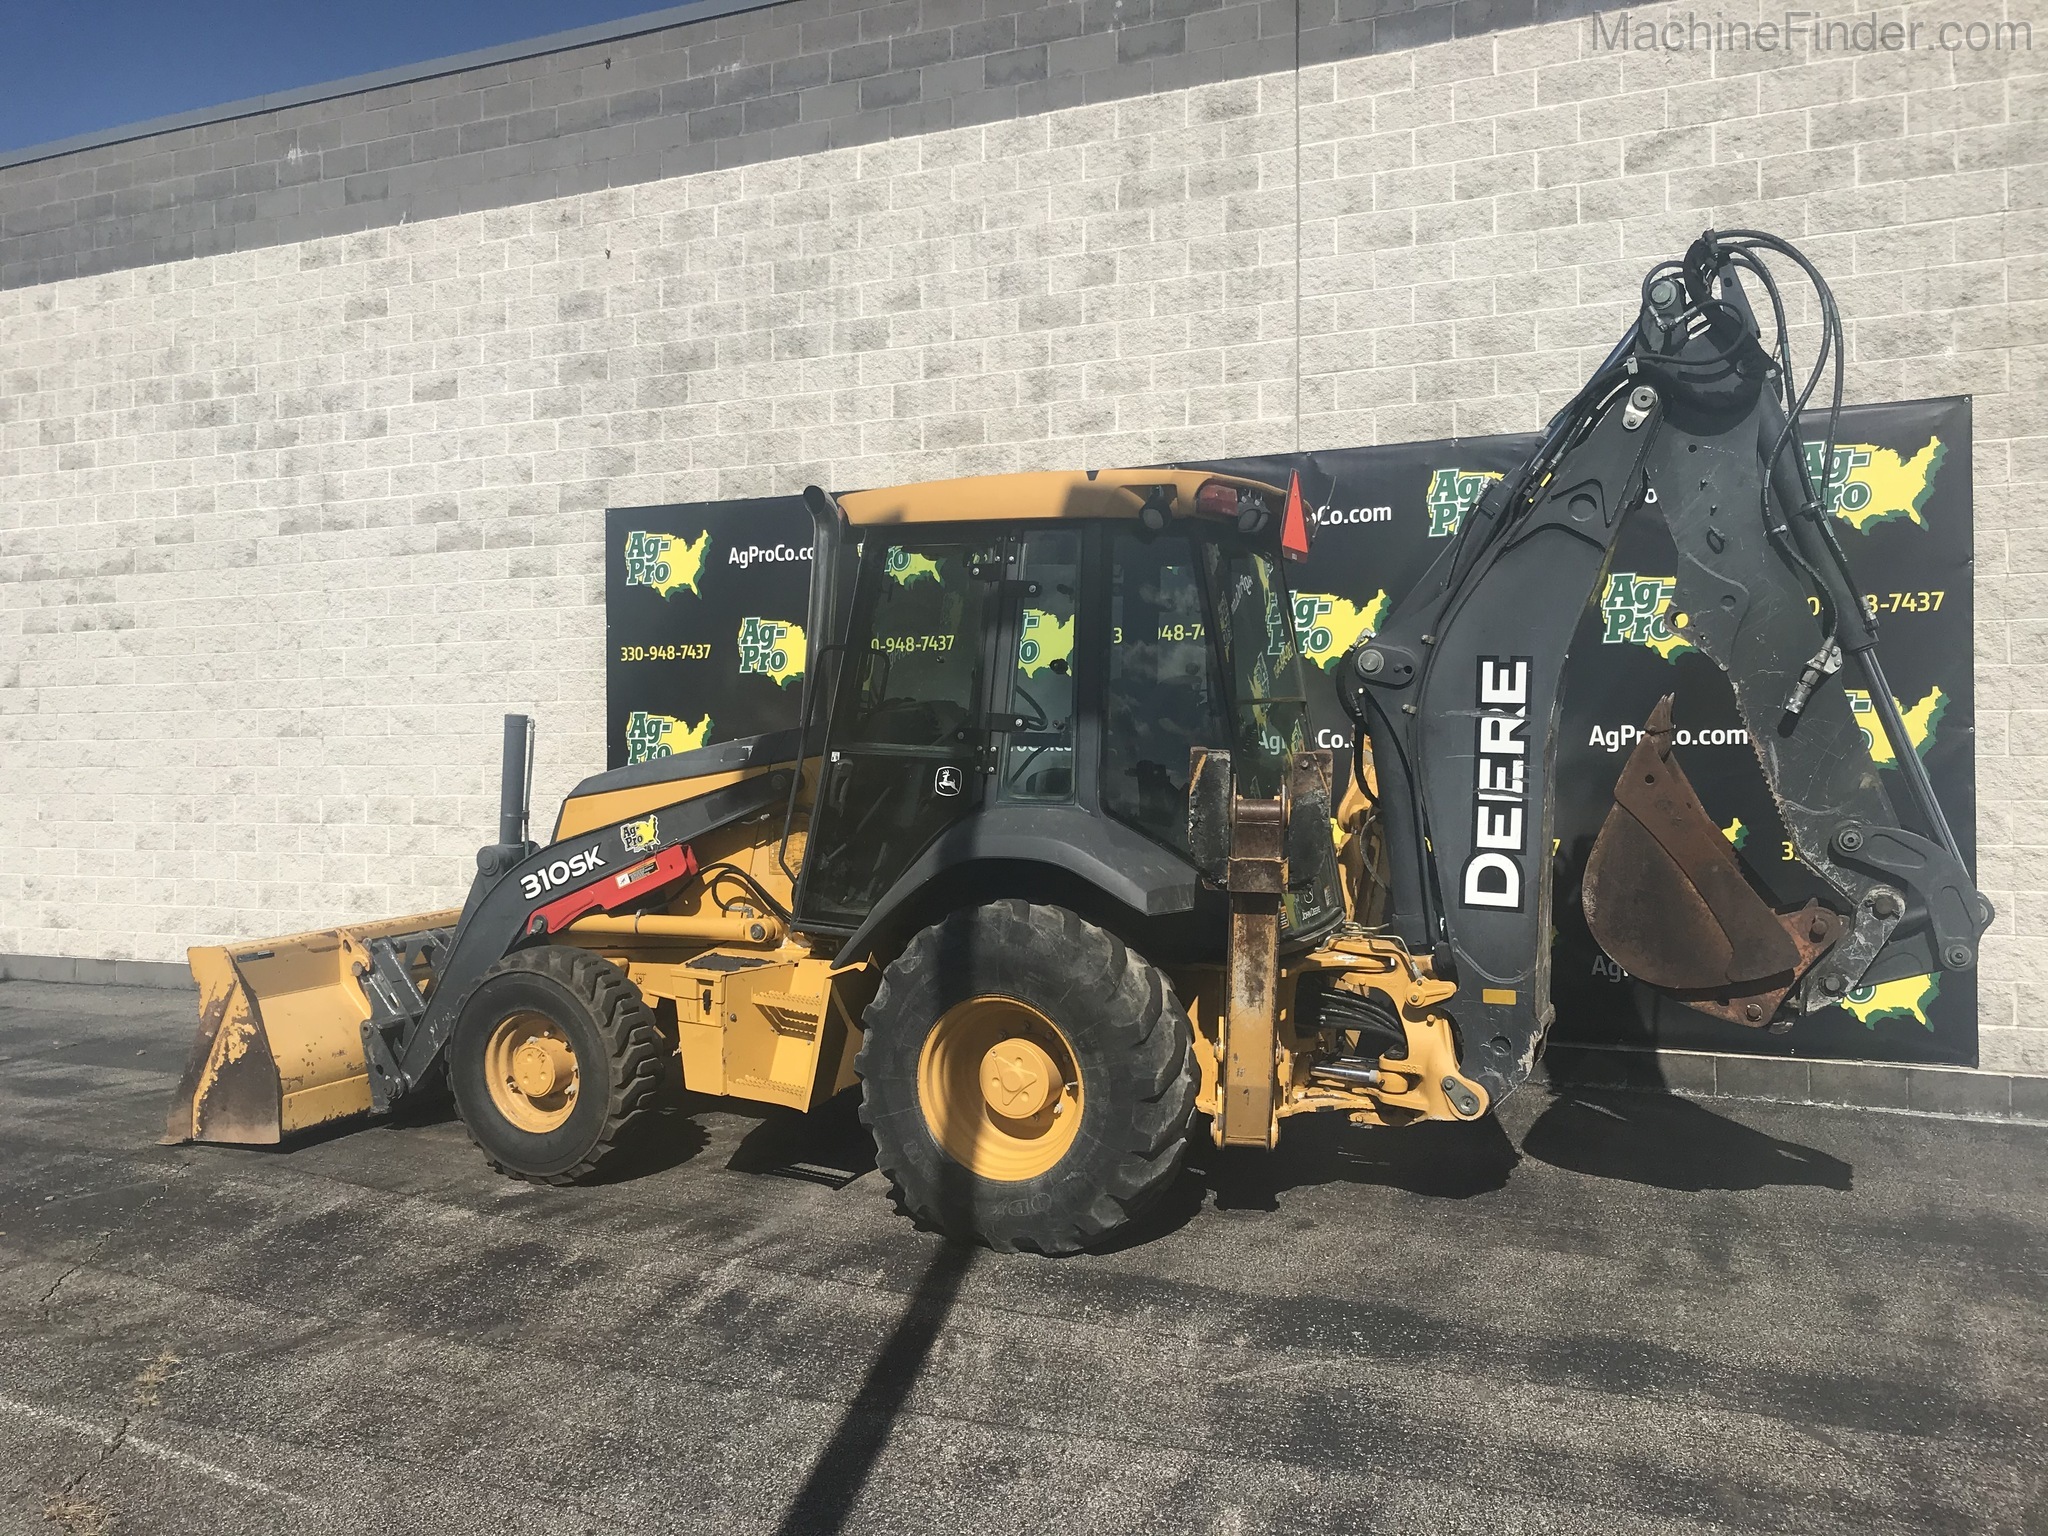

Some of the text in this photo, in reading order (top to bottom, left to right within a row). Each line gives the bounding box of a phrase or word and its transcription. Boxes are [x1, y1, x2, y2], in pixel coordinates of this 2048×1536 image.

[627, 531, 671, 562] Ag-
[728, 544, 813, 569] AgProCo.co
[626, 558, 671, 586] Pro
[740, 617, 787, 650] Ag-
[620, 643, 711, 662] 330-948-7437
[739, 645, 788, 674] Pro
[627, 711, 673, 744] Ag-
[1588, 724, 1749, 753] AgPro.com
[1463, 660, 1532, 909] DEERE
[625, 835, 643, 849] Pro
[519, 844, 606, 900] 310SK
